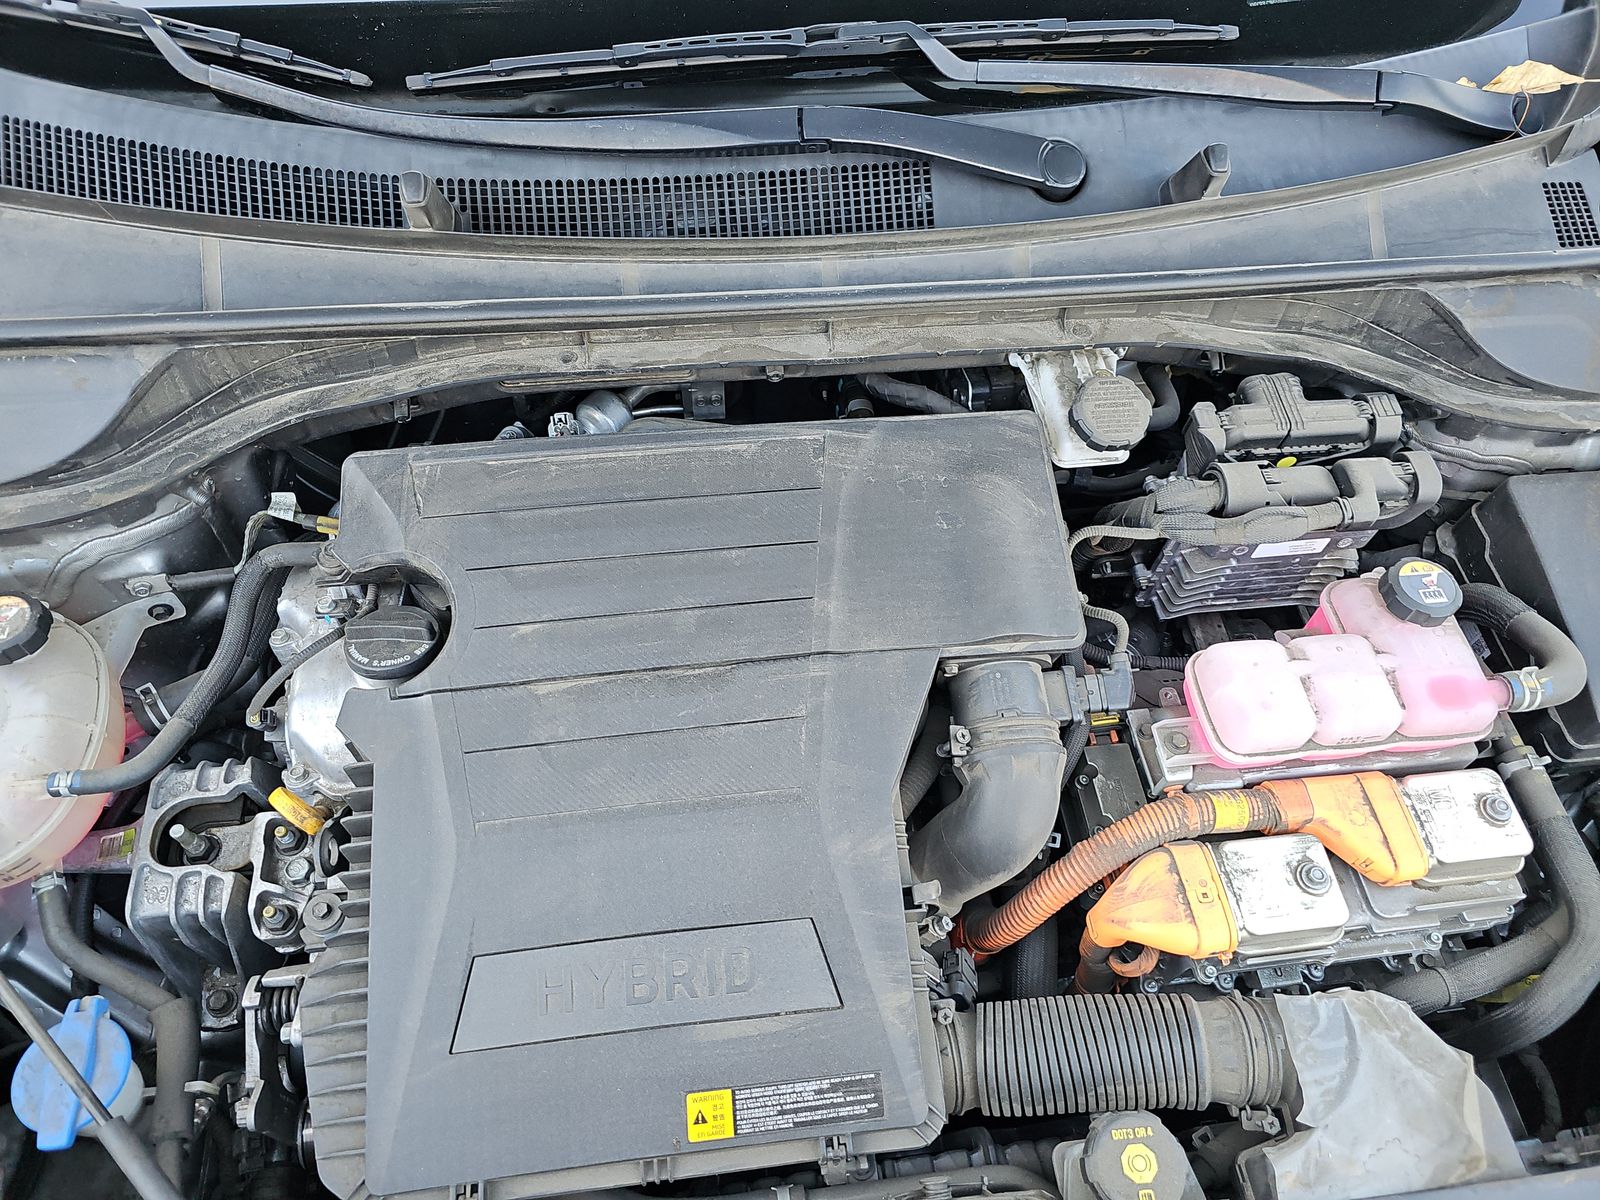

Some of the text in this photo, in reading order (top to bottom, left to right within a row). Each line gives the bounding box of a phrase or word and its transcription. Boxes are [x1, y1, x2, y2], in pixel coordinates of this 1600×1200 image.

[348, 644, 370, 665] MANUAL
[373, 655, 411, 666] OWNER'S
[540, 945, 758, 1016] HYBRID
[691, 1094, 725, 1103] WARNING
[1111, 1126, 1154, 1140] DOT3 OR 4
